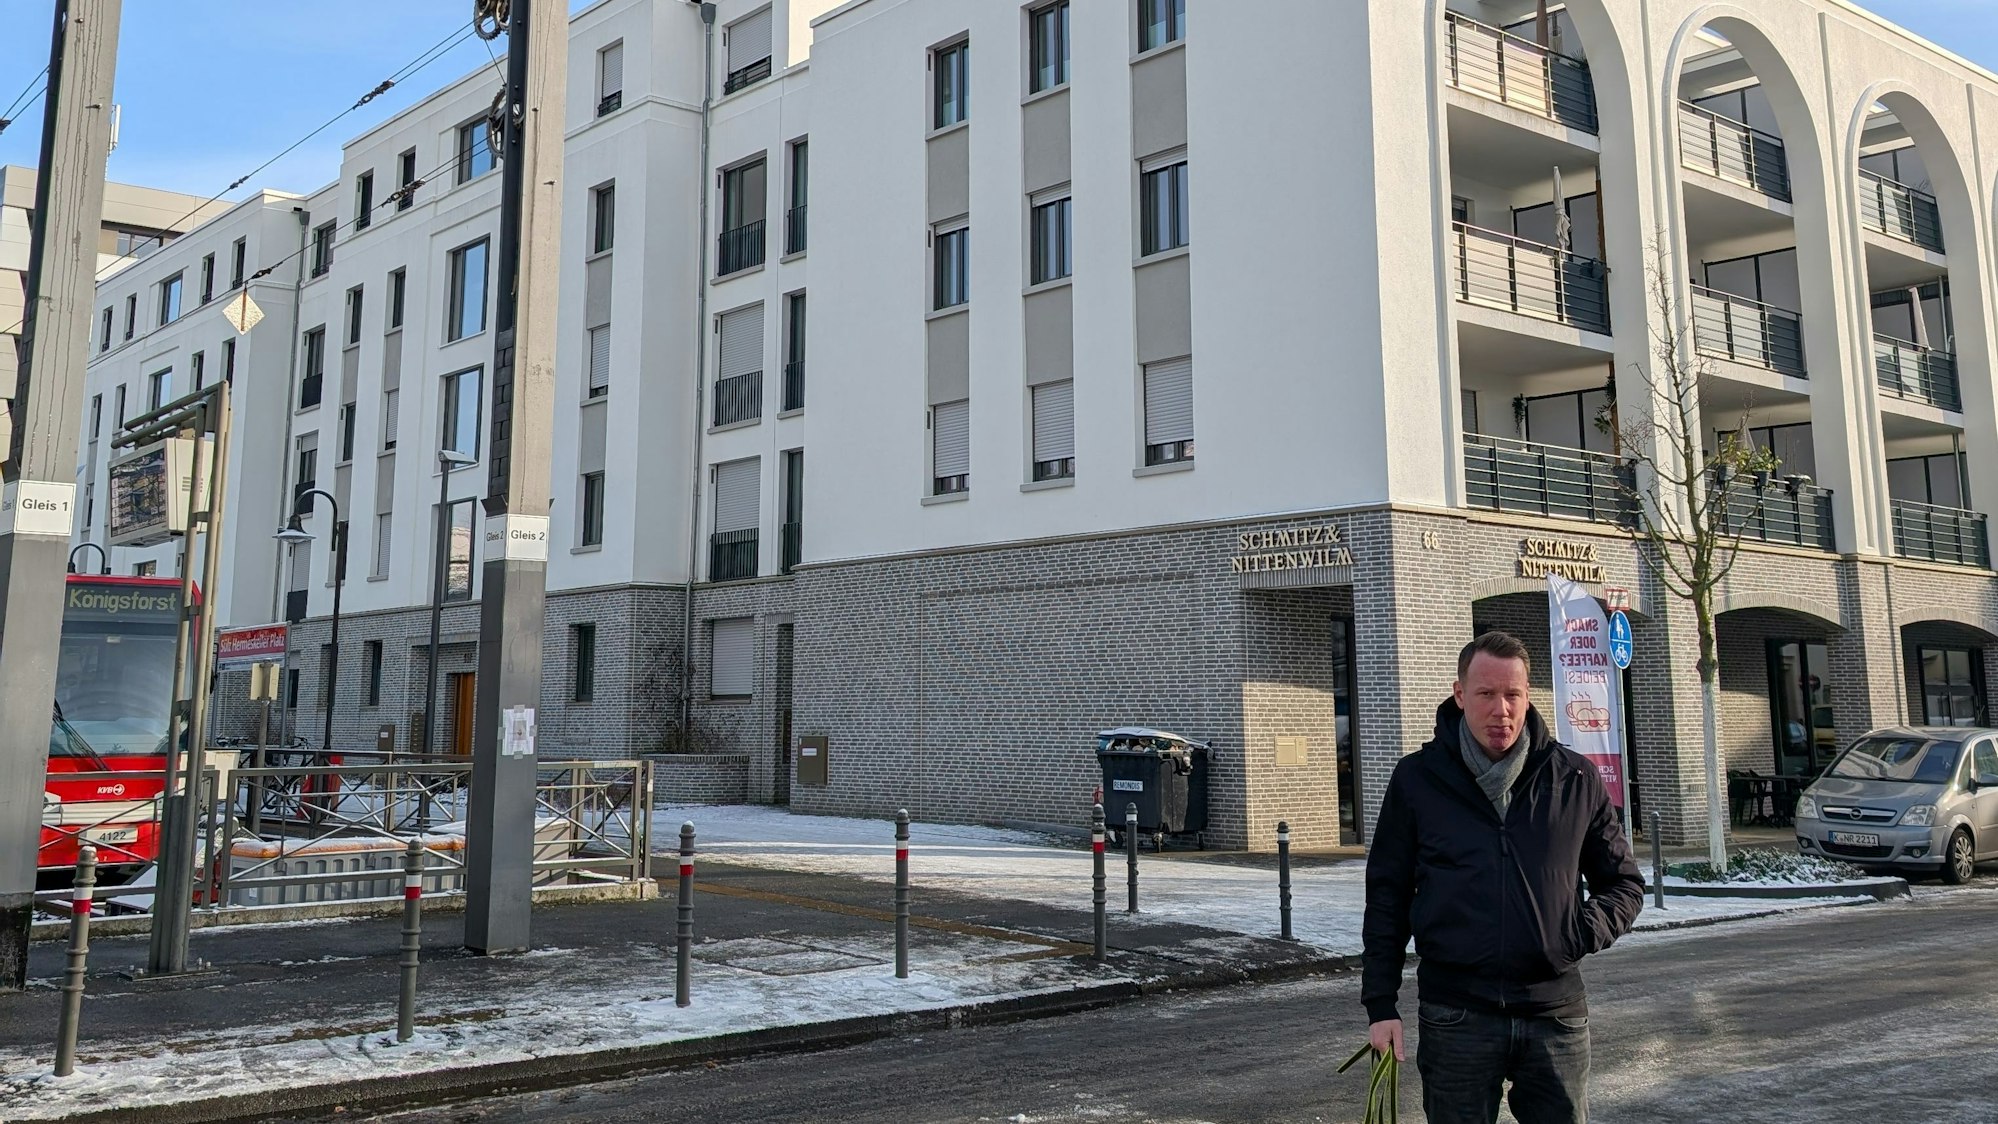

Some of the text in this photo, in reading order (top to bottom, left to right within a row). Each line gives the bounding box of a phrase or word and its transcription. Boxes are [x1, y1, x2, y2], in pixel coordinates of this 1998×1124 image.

[22, 498, 57, 511] Gleis
[62, 501, 68, 511] 1
[487, 532, 499, 541] Gleis
[511, 530, 545, 540] Gleis 2
[1423, 531, 1439, 549] 66
[1231, 547, 1354, 573] NITTENWILM
[1521, 559, 1606, 582] NITTENWILM
[69, 588, 177, 614] Königsforst
[220, 638, 232, 652] Sülz
[269, 632, 285, 648] Platz
[97, 786, 114, 794] KVB
[99, 831, 126, 841] 4122
[1855, 835, 1877, 845] 2211
